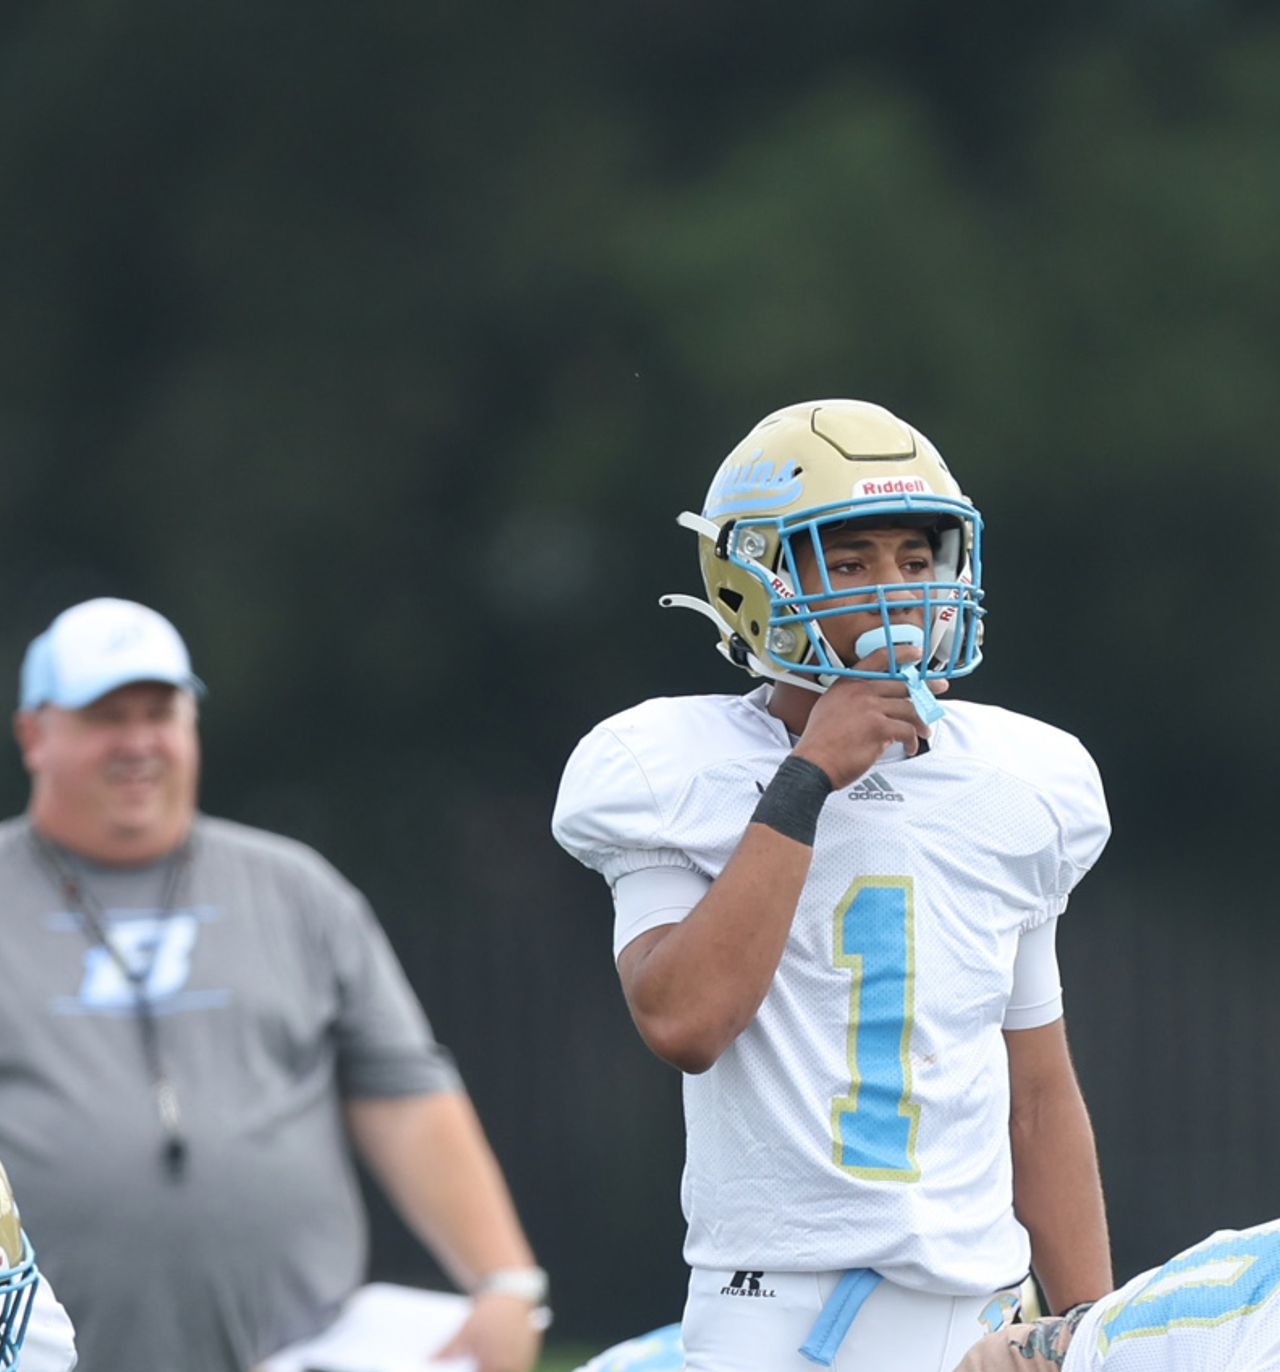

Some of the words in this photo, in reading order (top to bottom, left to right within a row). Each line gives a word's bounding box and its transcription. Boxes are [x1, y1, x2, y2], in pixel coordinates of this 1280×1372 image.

[862, 480, 924, 495] Riddell
[848, 789, 904, 802] adidas
[831, 875, 921, 1183] 1
[720, 1287, 777, 1298] RUSSELL
